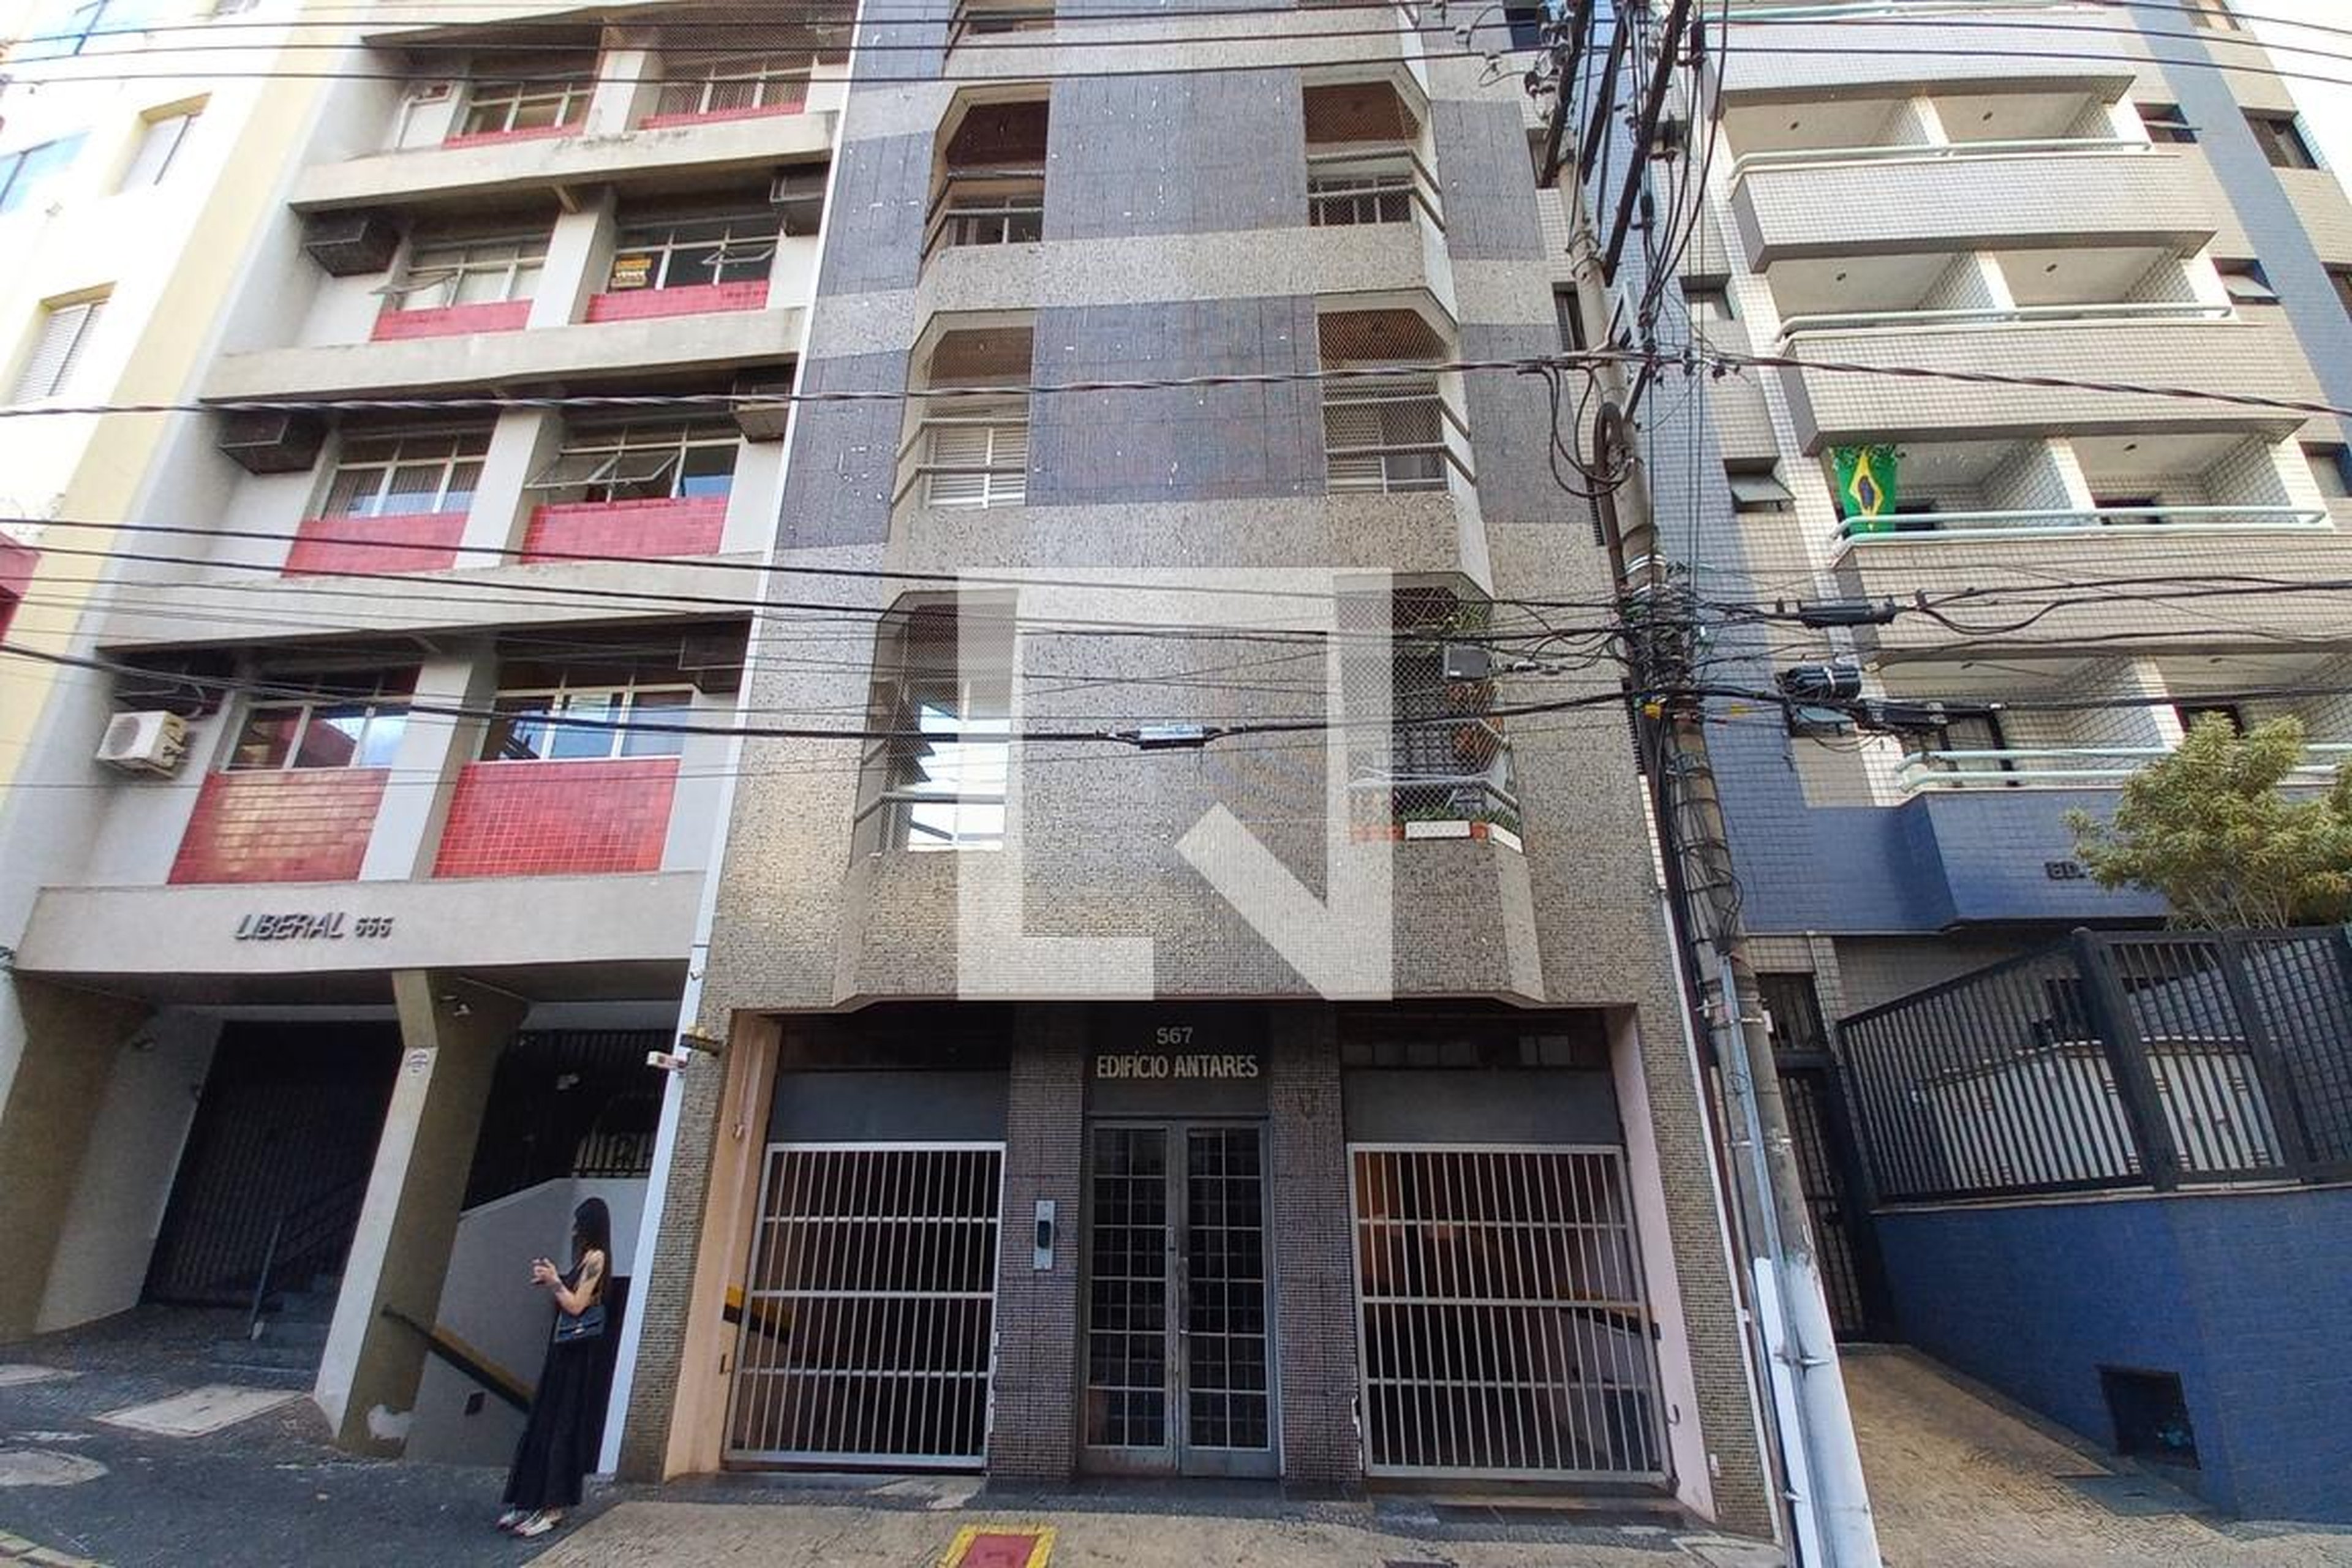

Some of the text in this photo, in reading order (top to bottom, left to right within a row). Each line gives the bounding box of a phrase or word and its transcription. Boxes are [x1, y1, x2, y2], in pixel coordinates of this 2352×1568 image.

[234, 912, 345, 940] LIBERAL
[1156, 1027, 1193, 1044] 567
[1097, 1050, 1259, 1078] EDIFÍCIO ANTARES
